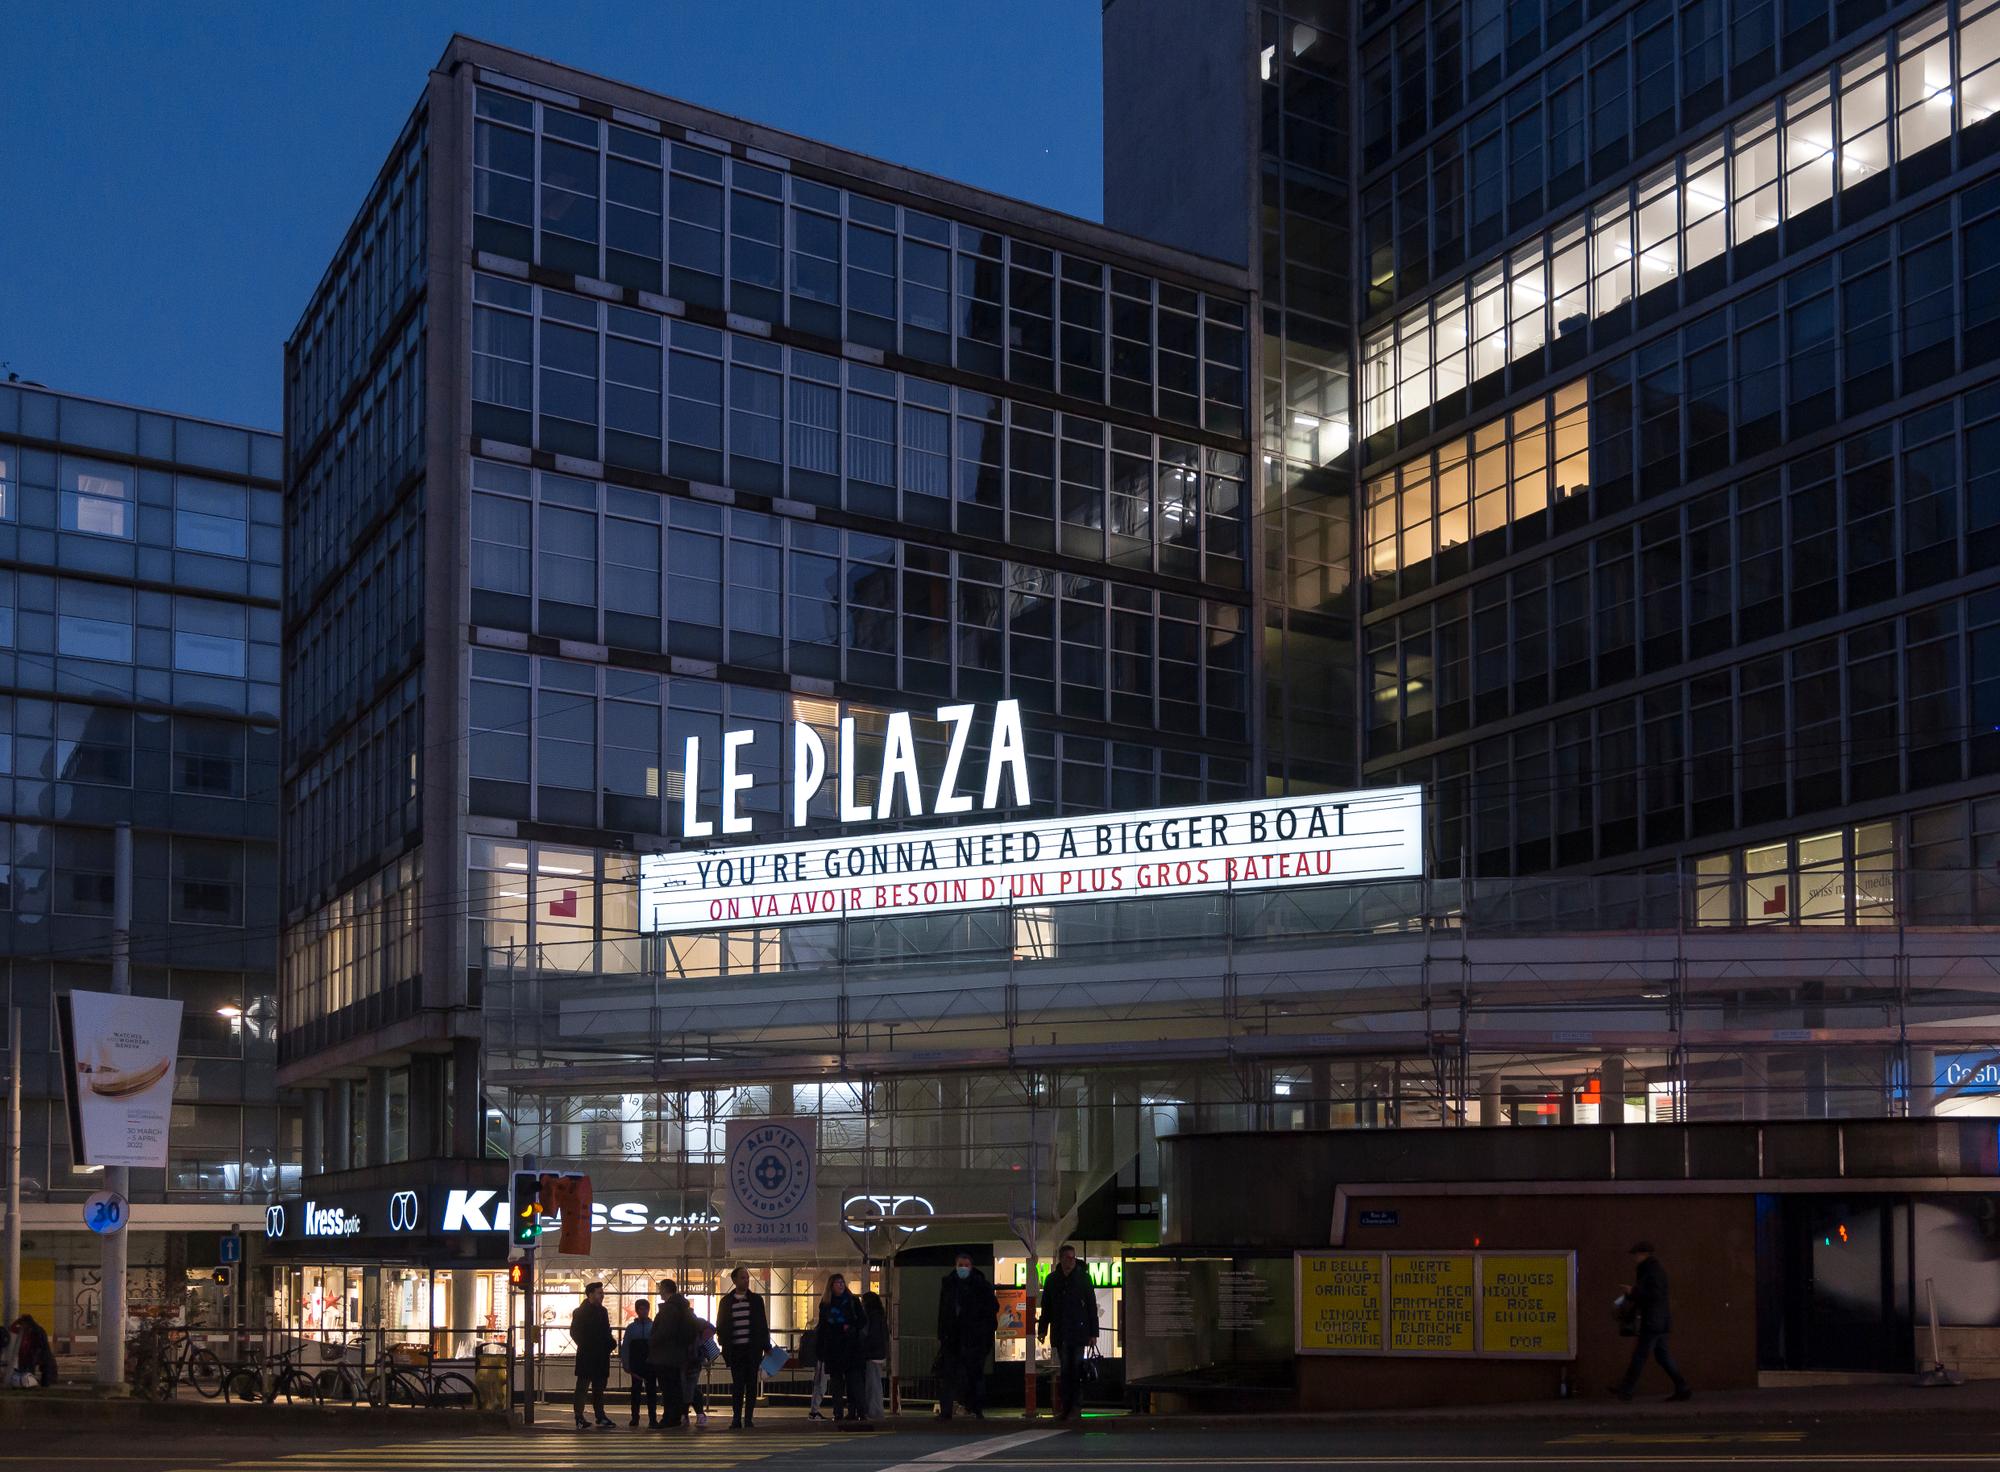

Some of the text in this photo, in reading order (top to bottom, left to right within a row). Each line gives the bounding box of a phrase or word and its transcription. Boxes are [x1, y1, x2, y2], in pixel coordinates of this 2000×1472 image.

[683, 699, 1031, 838] LE PLAZA
[697, 804, 1349, 889] YOU'RE GONNA NEED A BIGGER BOAT
[710, 850, 1332, 921] ON VA AVOIR BESOIN D'UN PLUS GROS BATEAU
[305, 1201, 361, 1238] Kress optic
[654, 1211, 721, 1236] optic
[733, 1222, 808, 1234] 022 301 21 10
[1312, 1261, 1452, 1272] LA BELLE VERTE
[1496, 1273, 1554, 1285] ROUGES
[1507, 1298, 1544, 1310] ROSE
[1518, 1311, 1557, 1323] NOIR
[1400, 1322, 1463, 1334] BLANCHE
